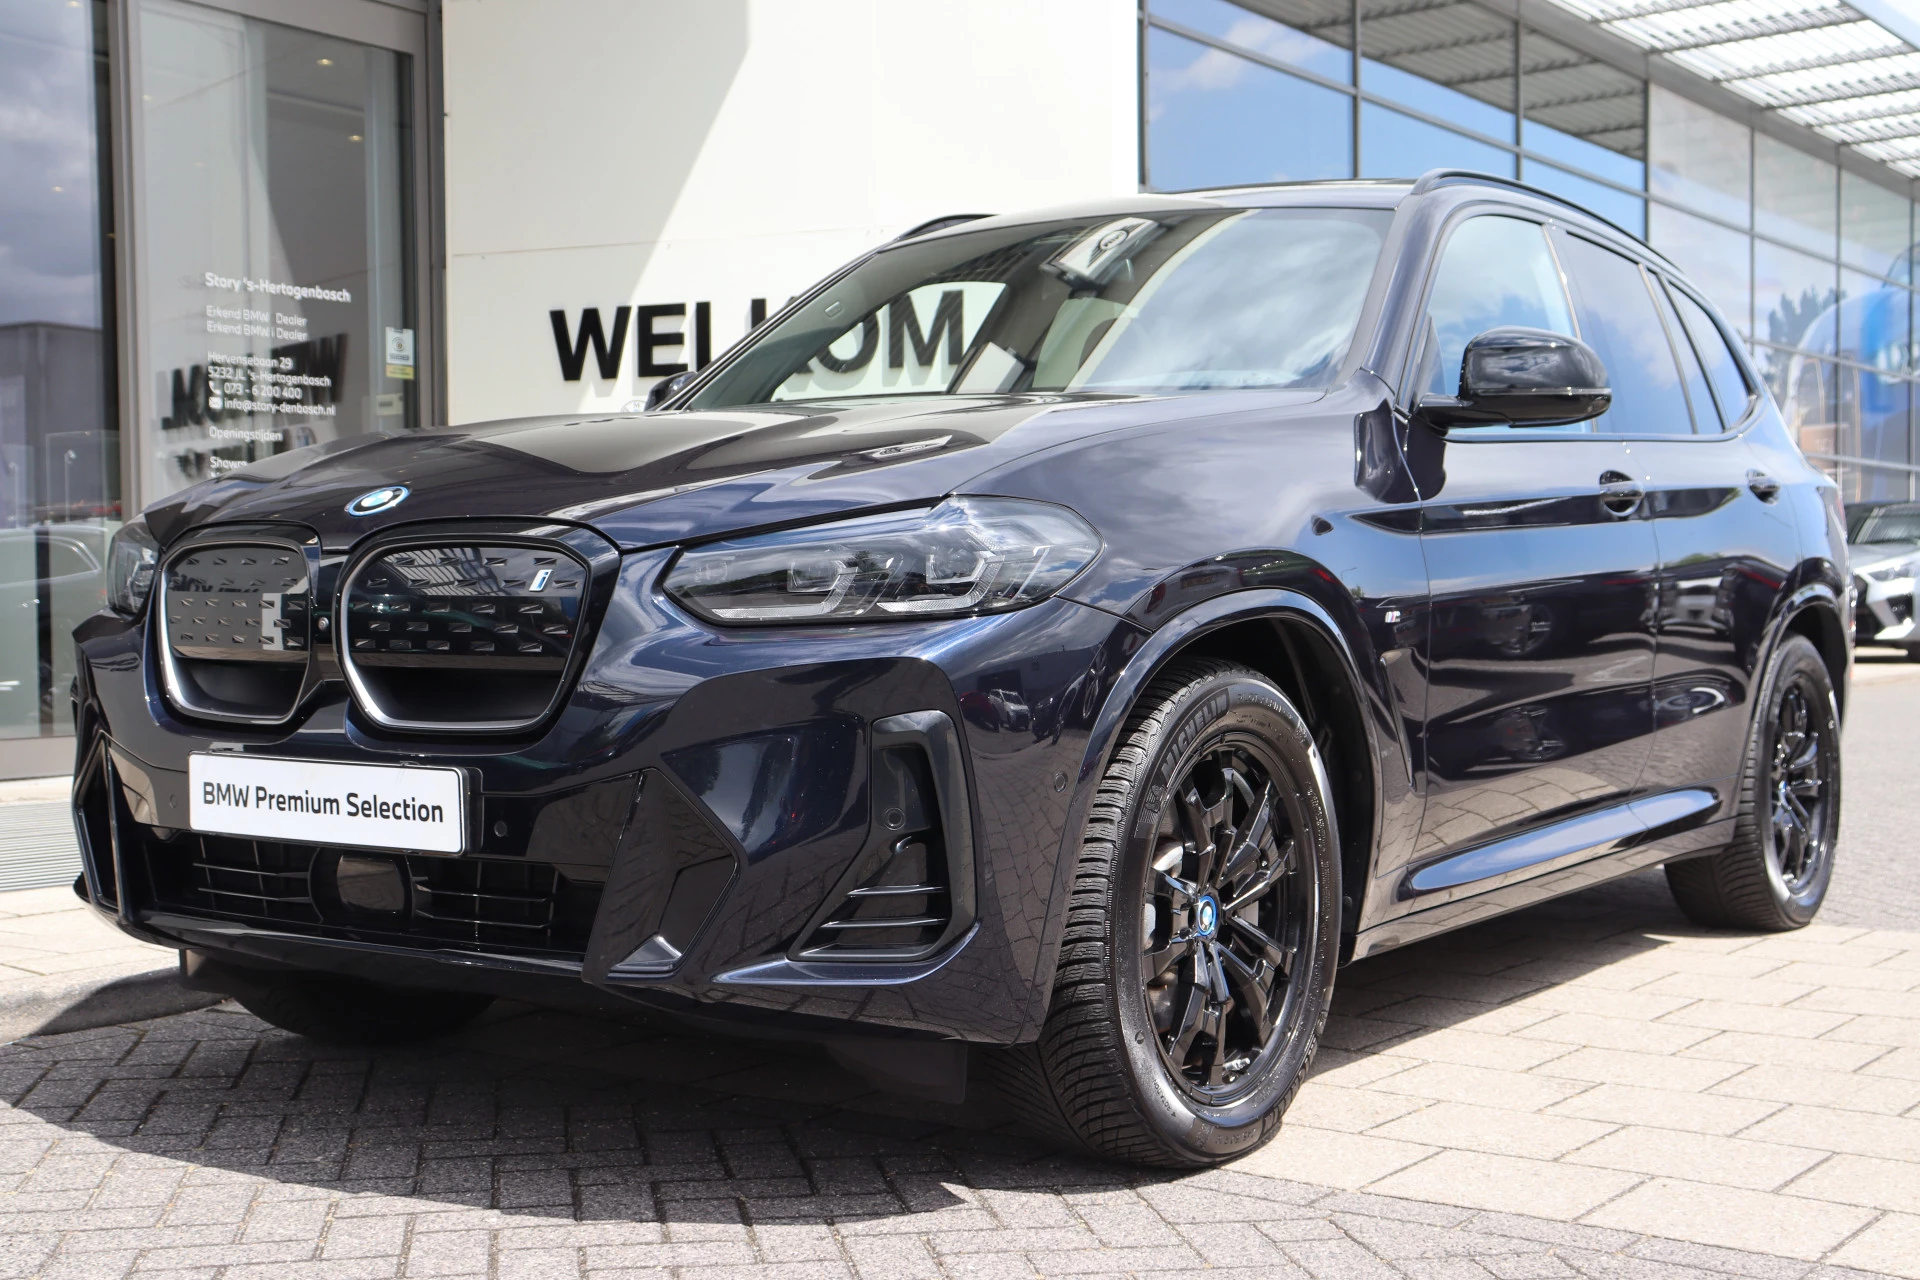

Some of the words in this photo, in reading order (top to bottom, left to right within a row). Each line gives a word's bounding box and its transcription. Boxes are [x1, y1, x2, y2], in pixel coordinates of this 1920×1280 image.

[204, 271, 241, 293] Story
[205, 305, 242, 321] Erkend
[242, 307, 270, 322] BMW
[275, 312, 308, 328] Dealer
[206, 320, 242, 335] Erkend
[243, 323, 270, 337] BMW
[276, 327, 308, 342] Dealer
[207, 351, 278, 368] Hervensebaan
[279, 356, 293, 370] 29
[207, 365, 233, 379] 5232
[234, 368, 246, 380] JL
[223, 382, 244, 395] 073
[252, 385, 258, 396] 6
[259, 386, 281, 398] 200
[281, 387, 303, 400] 400
[208, 426, 284, 443] Openingstijden
[1160, 693, 1229, 779] MICHELIN
[202, 780, 250, 809] BMW
[255, 785, 340, 816] Premium
[346, 792, 445, 823] Selection
